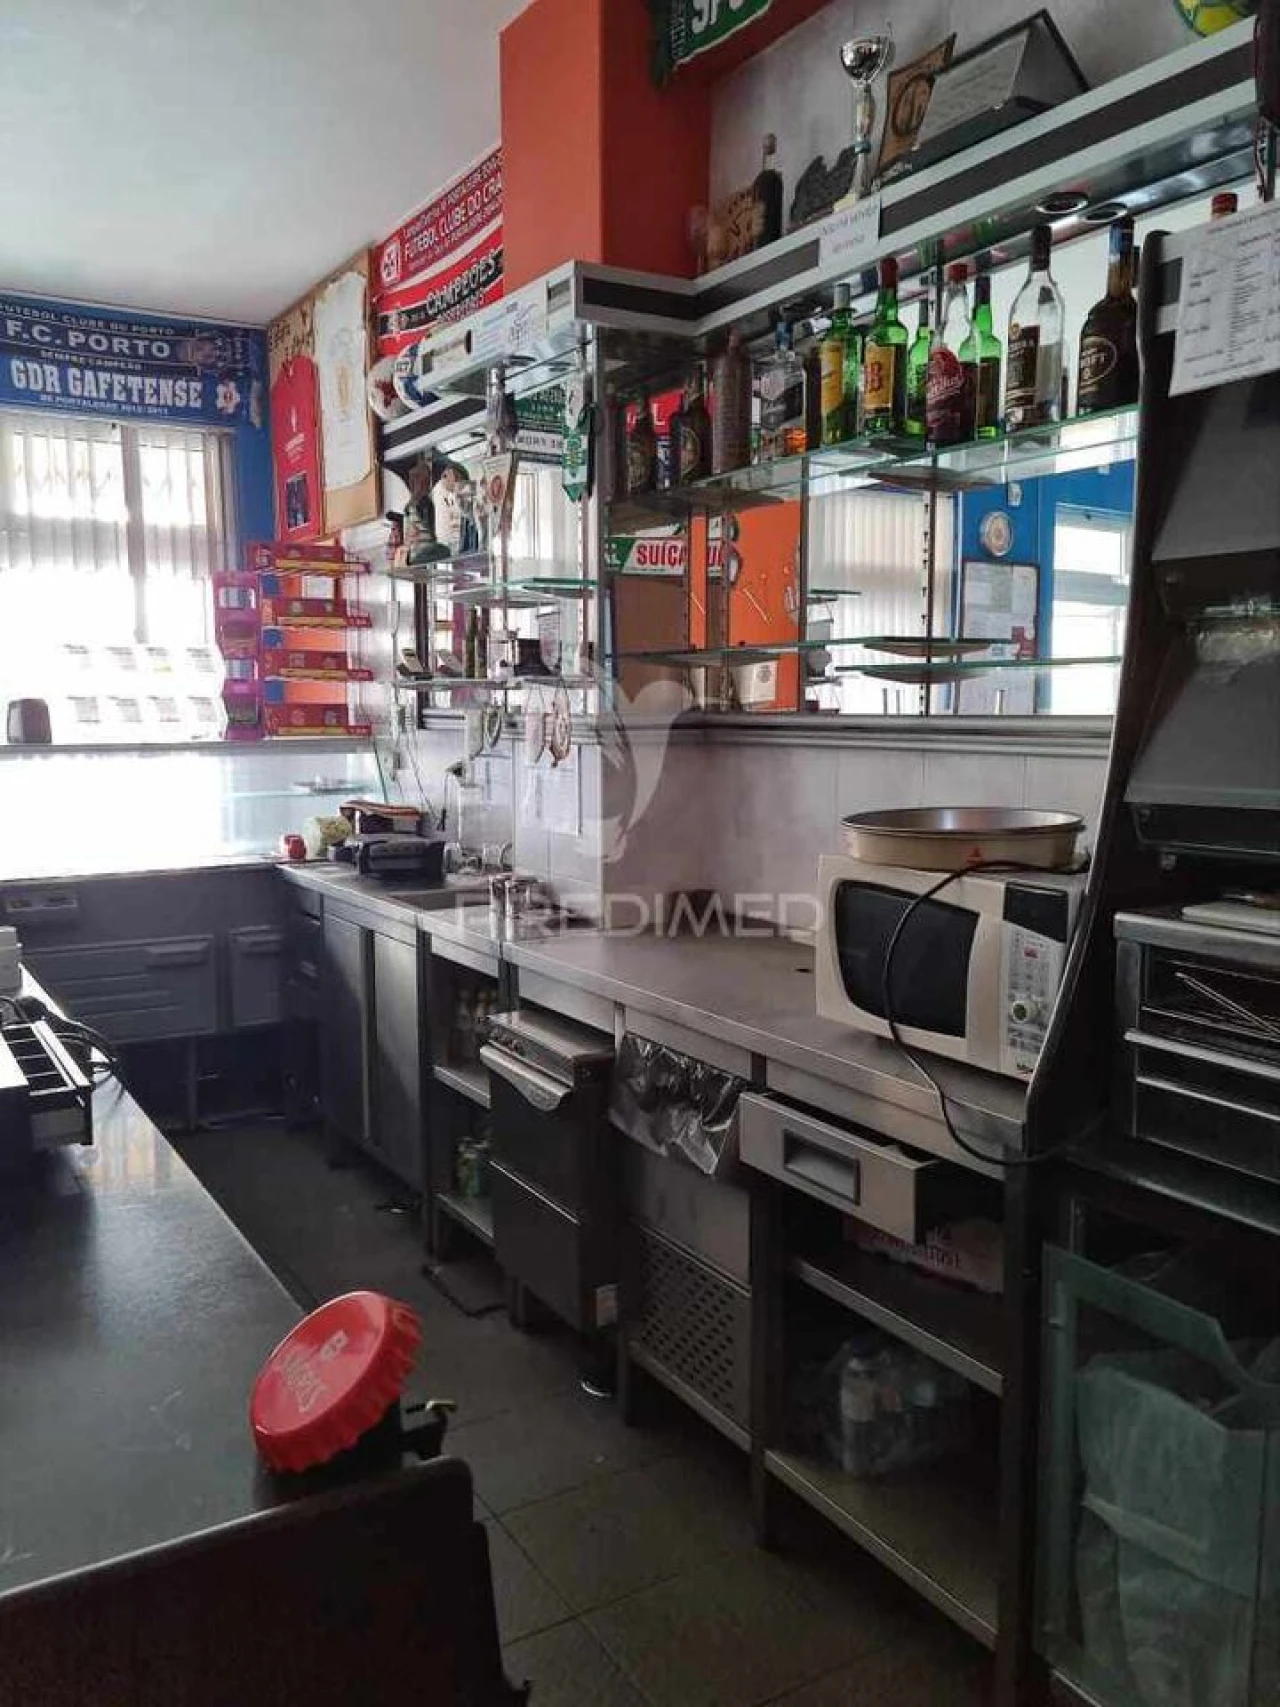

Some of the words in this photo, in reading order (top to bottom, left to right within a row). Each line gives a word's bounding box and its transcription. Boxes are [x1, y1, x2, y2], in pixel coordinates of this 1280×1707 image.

[6, 318, 62, 345] F.C.
[68, 329, 171, 359] PORTO
[11, 358, 61, 394] GDR
